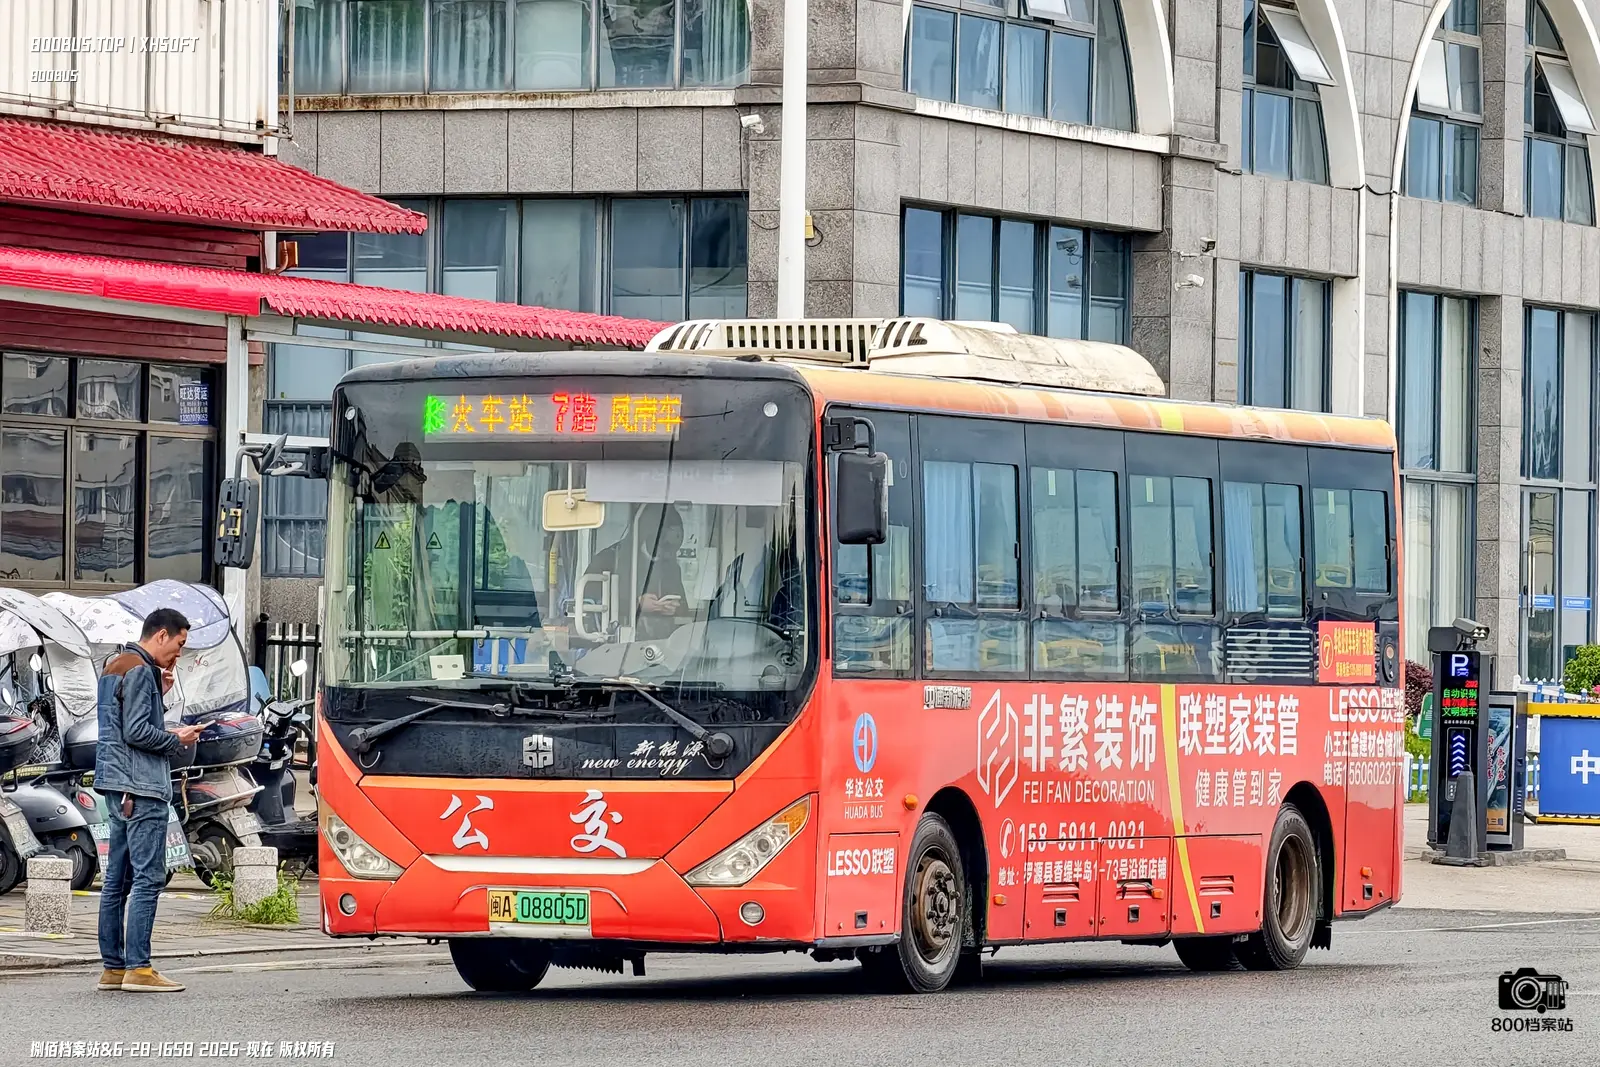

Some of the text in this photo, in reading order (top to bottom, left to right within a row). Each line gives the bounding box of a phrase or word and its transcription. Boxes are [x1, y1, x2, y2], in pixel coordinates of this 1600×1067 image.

[452, 393, 535, 433] 火车站
[552, 392, 598, 433] 7路
[1451, 653, 1469, 677] P
[1023, 693, 1158, 773] 非繁装饰
[1178, 691, 1300, 757] 联塑家装管
[629, 739, 704, 759] 新能源
[581, 757, 692, 776] new energy
[844, 777, 884, 799] 华达公交
[1023, 779, 1156, 804] FEI FAN DECORATION
[1195, 767, 1284, 808] 健康管到家
[439, 789, 627, 858] 公交
[844, 804, 884, 819] HUADA BUS
